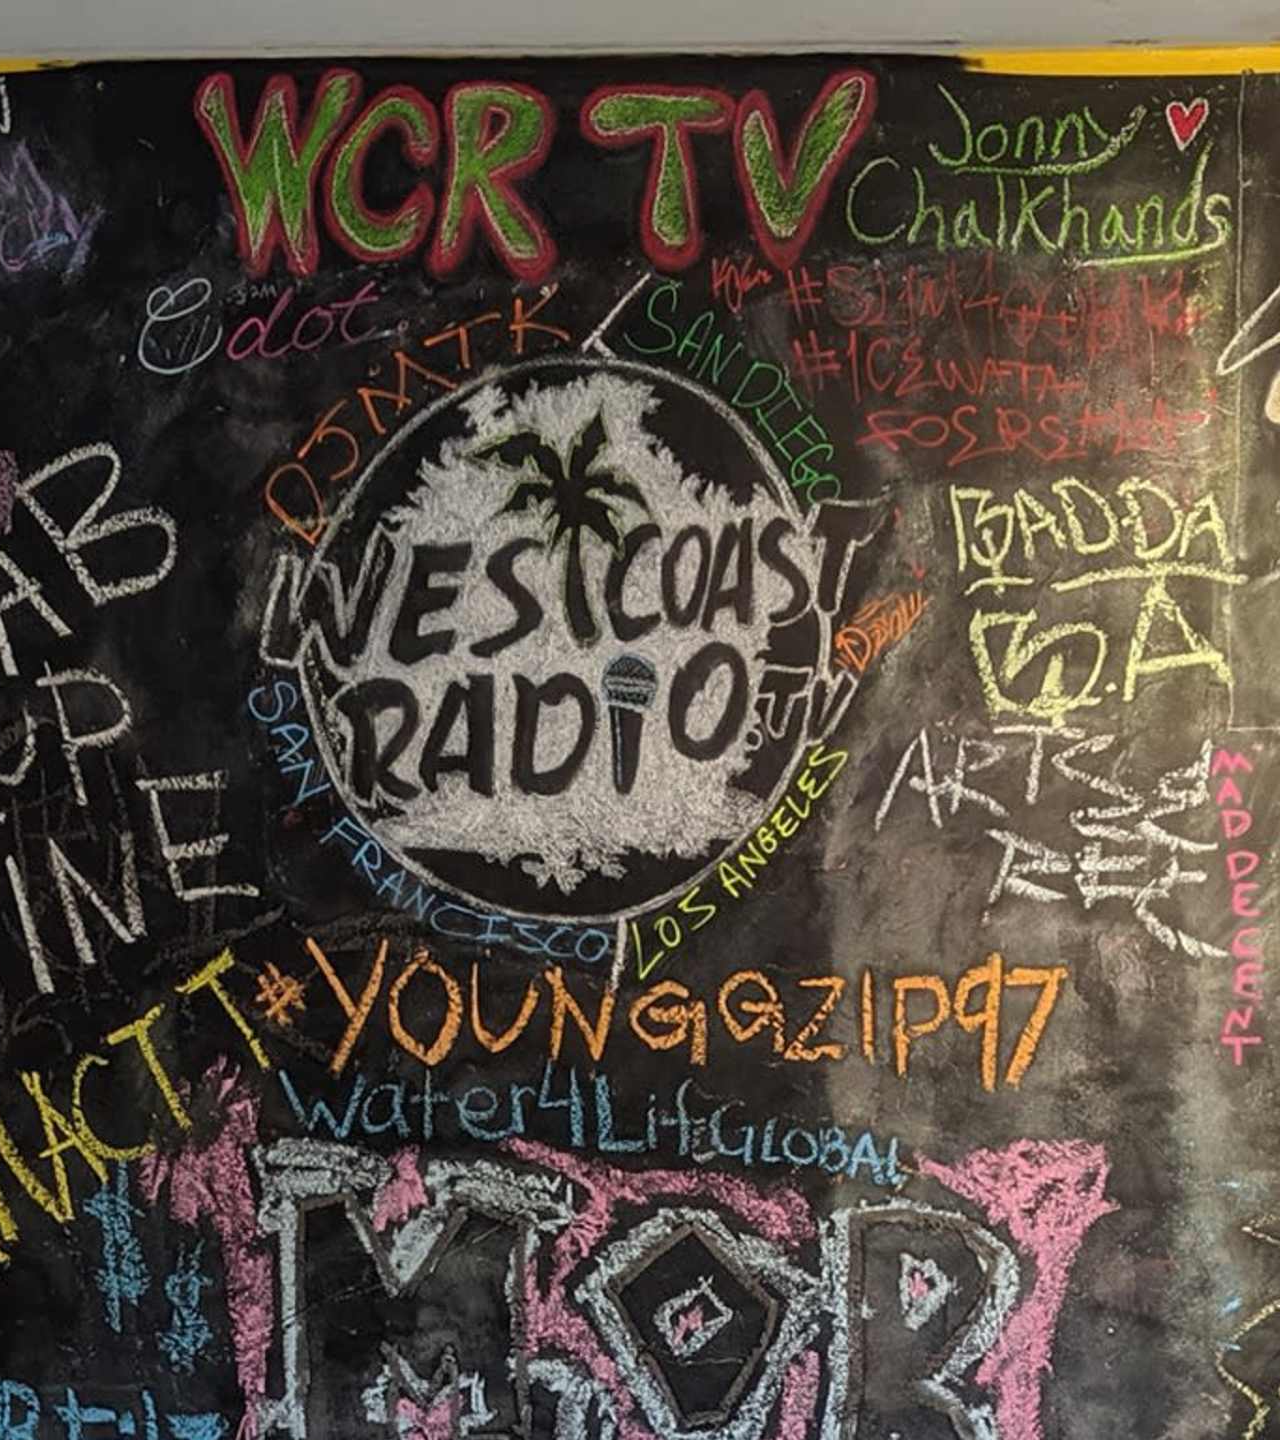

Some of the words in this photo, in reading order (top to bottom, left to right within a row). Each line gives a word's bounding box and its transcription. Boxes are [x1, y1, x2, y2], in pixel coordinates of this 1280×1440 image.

[194, 68, 556, 283] WCR
[581, 67, 877, 275] TV
[338, 640, 750, 803] RADIO
[628, 888, 718, 980] LOS
